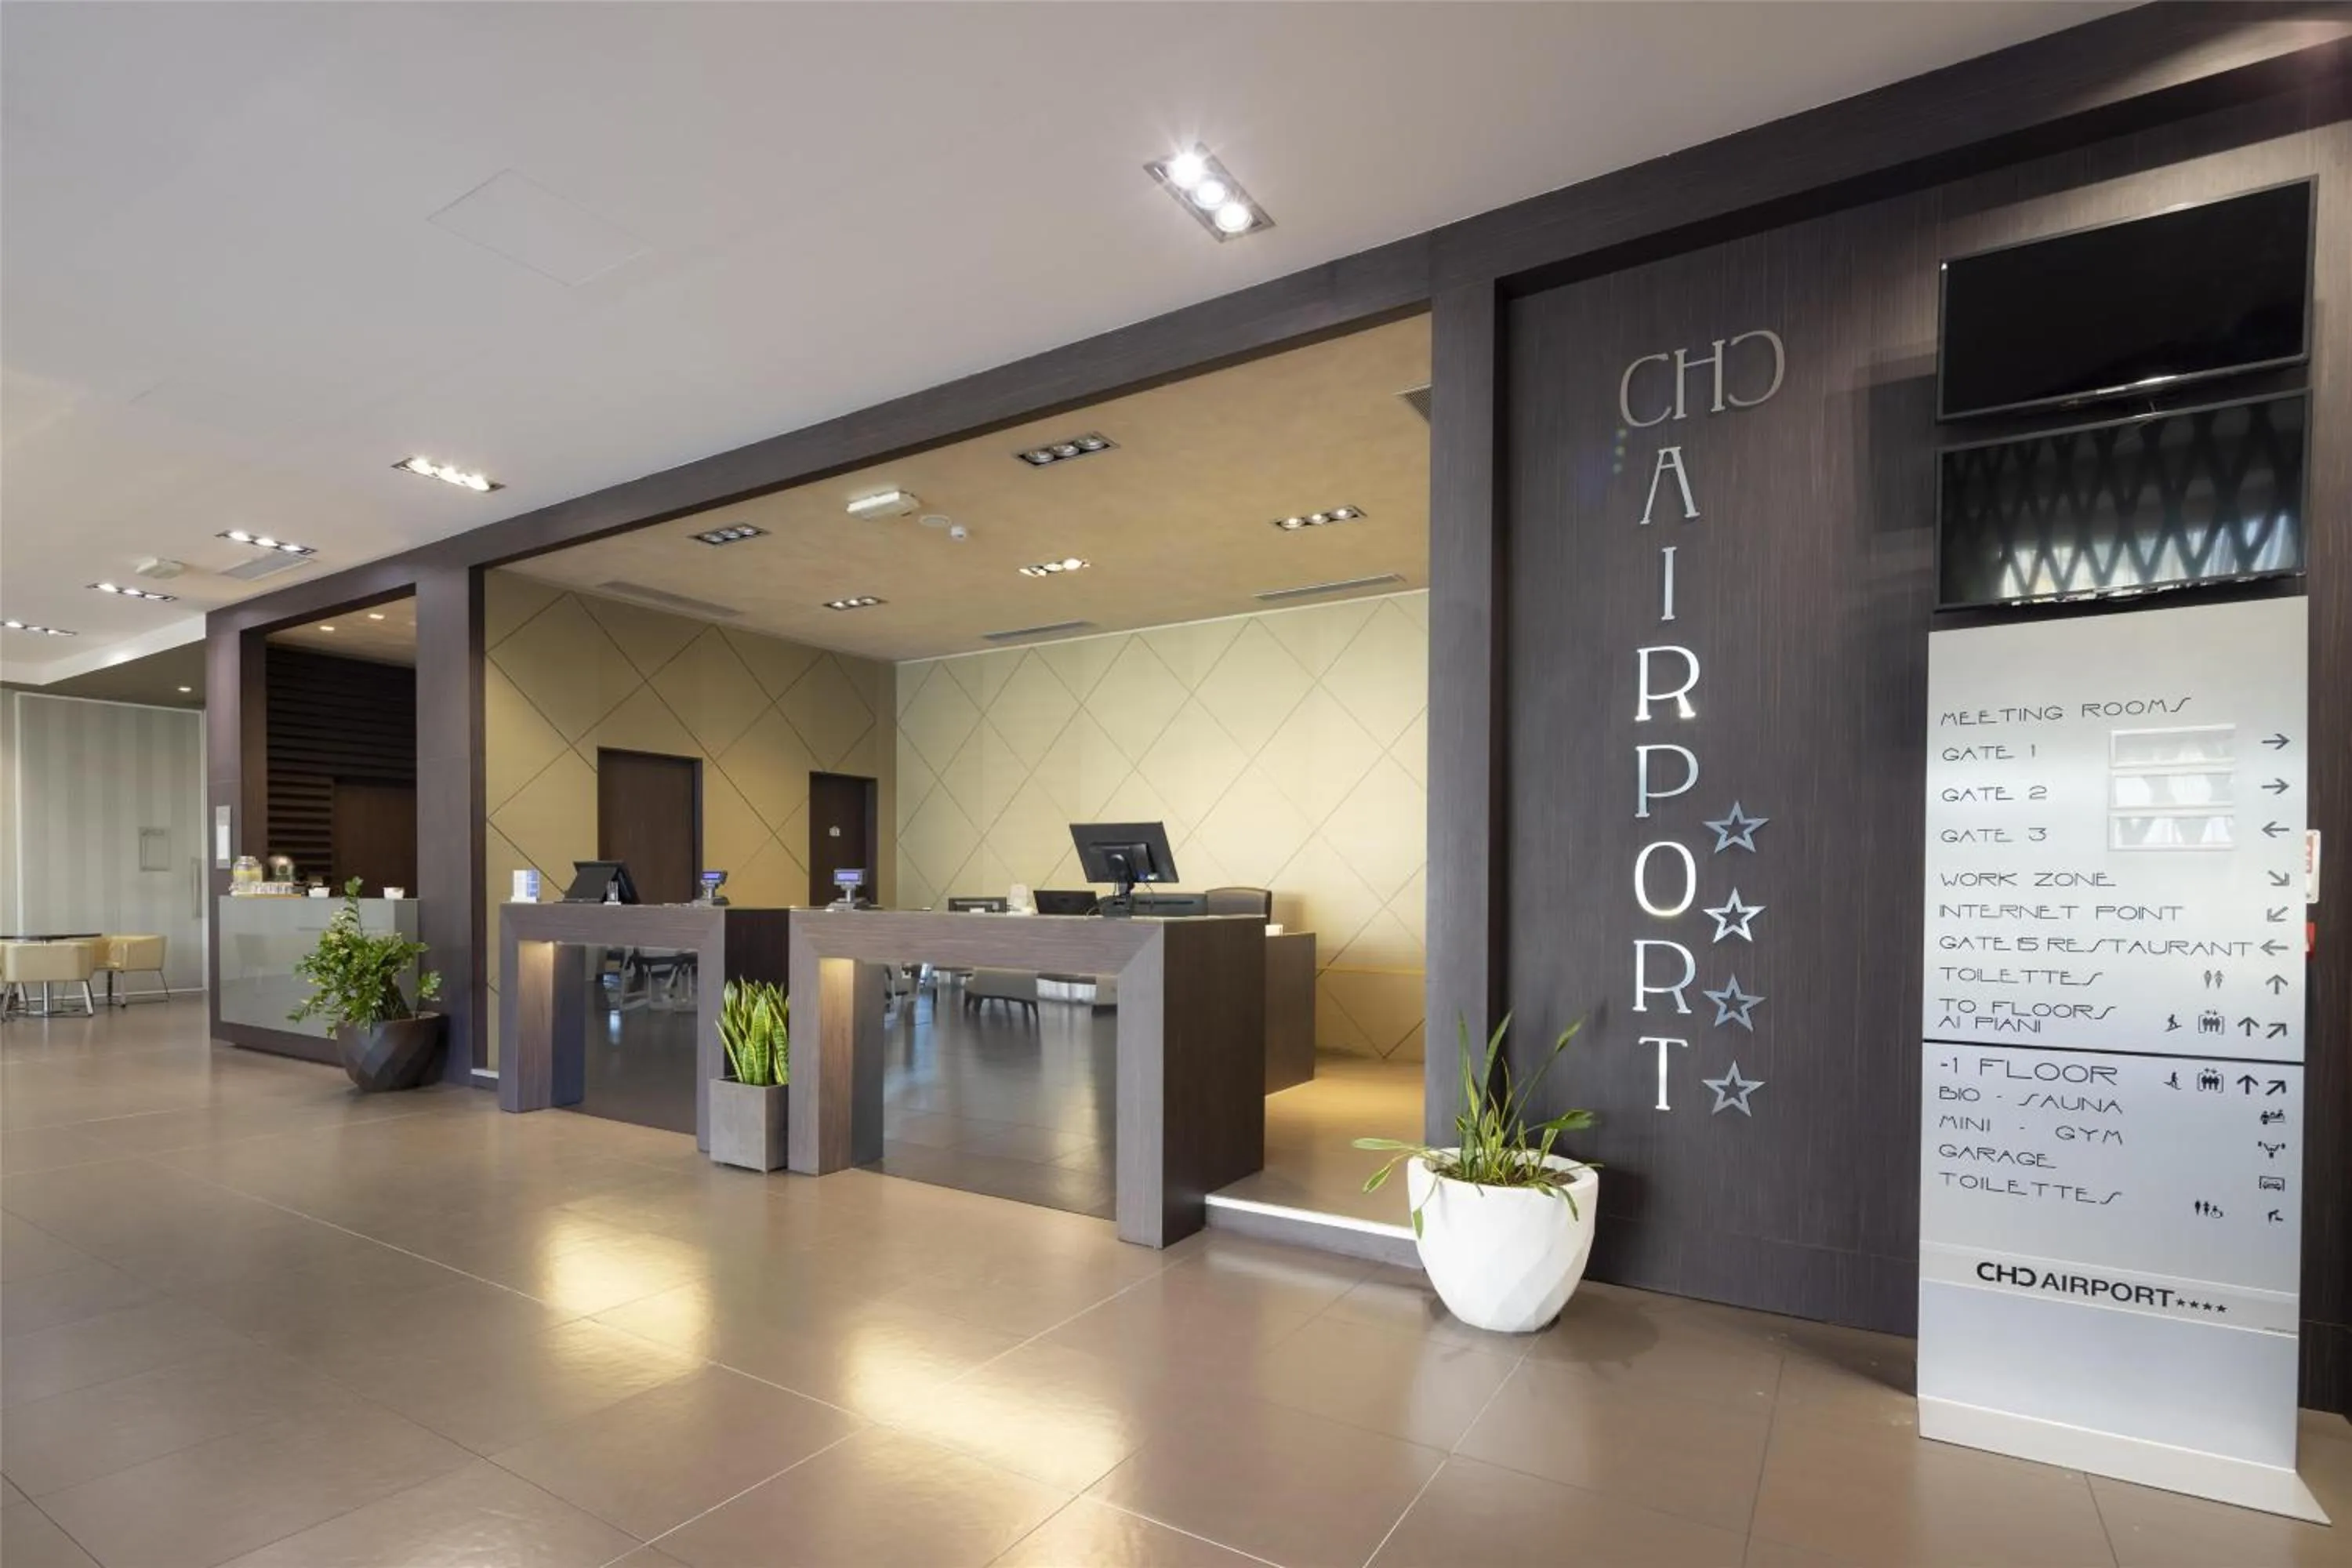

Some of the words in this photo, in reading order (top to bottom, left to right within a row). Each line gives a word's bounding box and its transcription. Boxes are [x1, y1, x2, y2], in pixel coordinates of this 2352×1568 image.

[1940, 706, 2063, 726] MEETING
[2082, 697, 2191, 717] ROOMS
[1942, 746, 2015, 761] GATE
[2031, 744, 2036, 758] 1
[1632, 446, 1701, 1111] AIRPORT
[1941, 786, 2014, 802] GATE
[2028, 786, 2048, 800] 2
[1940, 828, 2013, 843] GATE
[2028, 827, 2047, 842] 3
[1940, 872, 2018, 887] WORK
[2034, 872, 2116, 887] ZONE
[1939, 904, 2079, 920] INTERNET
[2096, 906, 2183, 920] POINT
[1939, 935, 2011, 951] GATE
[2046, 938, 2254, 956] RESTAURANT
[1939, 967, 2103, 985] TOILETTES
[1939, 998, 1976, 1014] TO
[1992, 1001, 2117, 1020] FLOORS
[1938, 1015, 1961, 1029] AI
[1975, 1016, 2041, 1033] PIANI
[1940, 1057, 1958, 1074] -1
[1980, 1058, 2118, 1085] FLOOR
[1939, 1086, 1981, 1102] BIO
[2017, 1094, 2123, 1114] SAUNA
[1939, 1116, 1991, 1132] MINI
[2055, 1125, 2123, 1145] GYM
[1938, 1144, 2057, 1169] GARAGE
[1938, 1172, 2123, 1205] TOILETTES
[2040, 1272, 2176, 1308] AIRPORT
